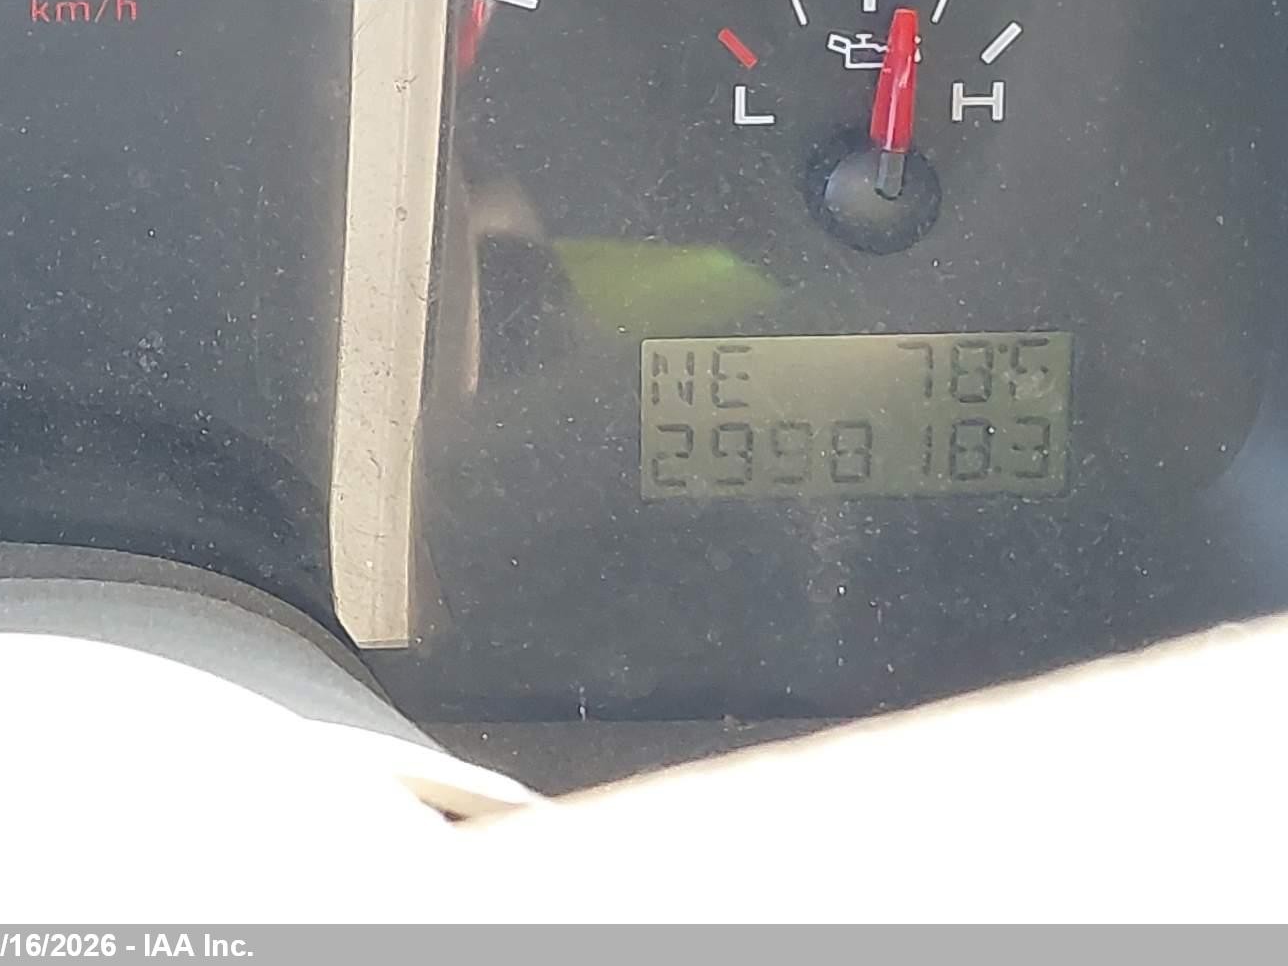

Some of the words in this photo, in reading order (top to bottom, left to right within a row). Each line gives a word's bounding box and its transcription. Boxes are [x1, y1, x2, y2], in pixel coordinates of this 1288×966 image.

[733, 86, 775, 125] L
[951, 81, 1005, 122] H
[651, 344, 752, 409] NE
